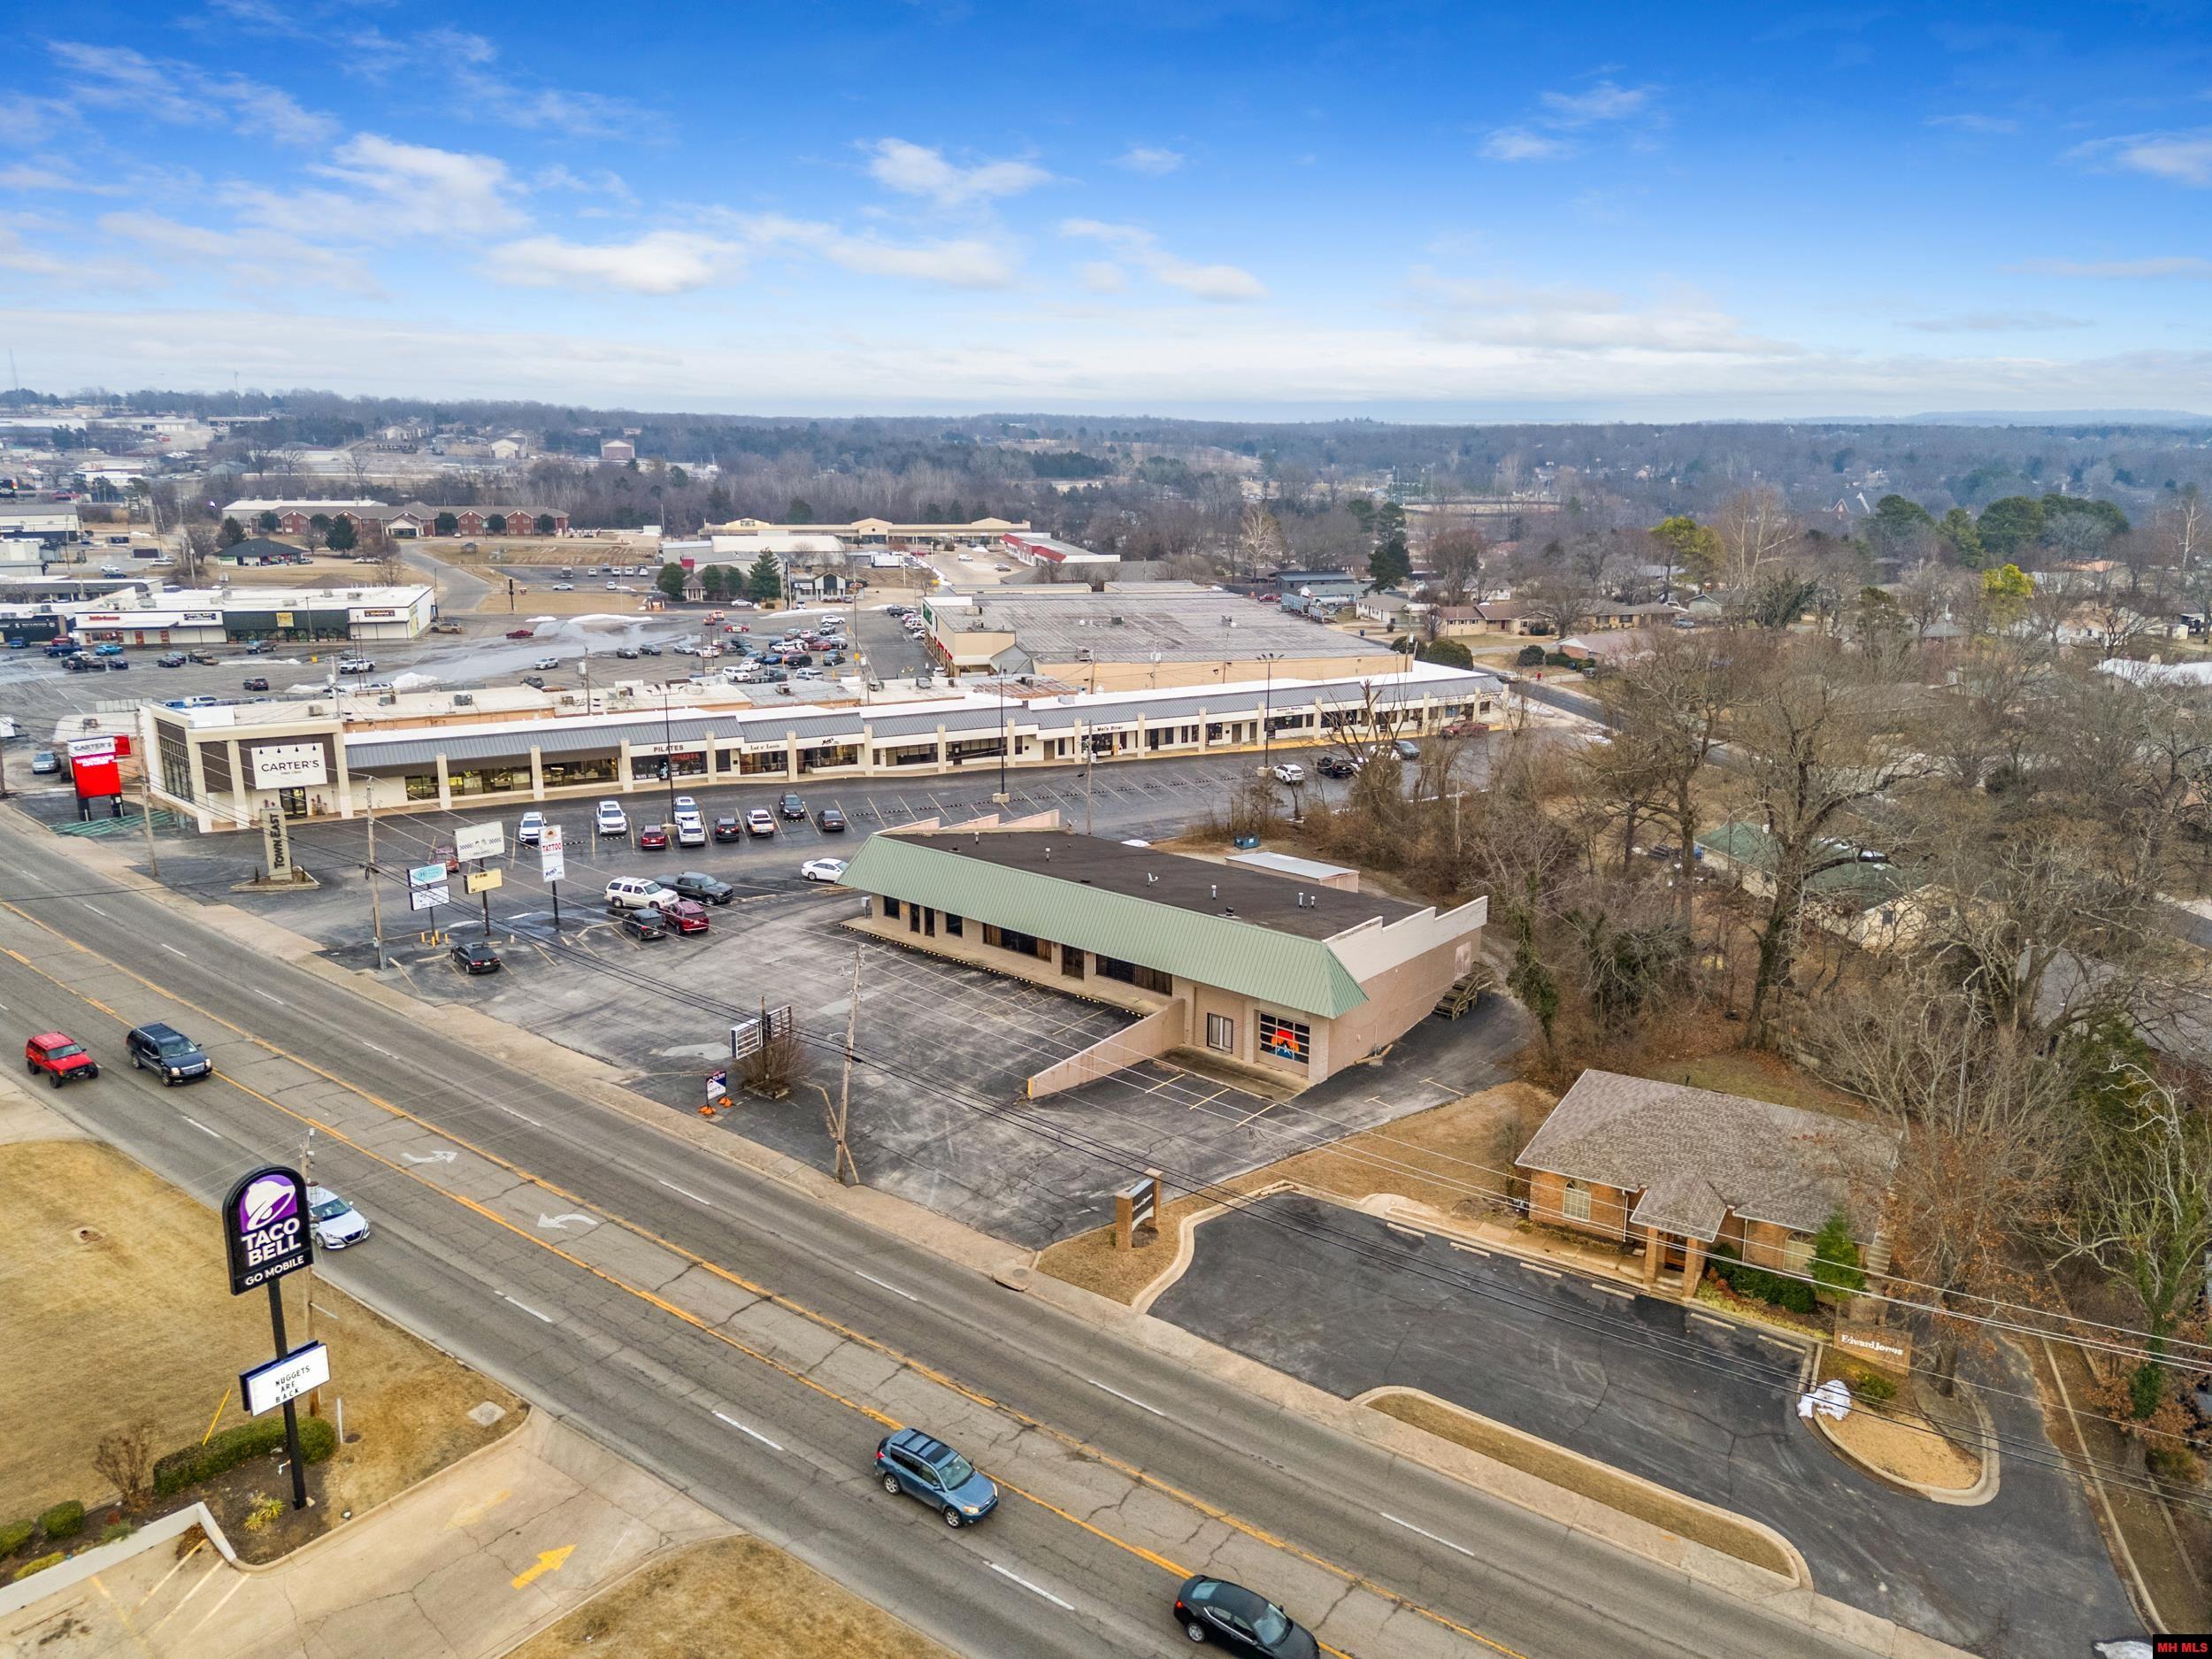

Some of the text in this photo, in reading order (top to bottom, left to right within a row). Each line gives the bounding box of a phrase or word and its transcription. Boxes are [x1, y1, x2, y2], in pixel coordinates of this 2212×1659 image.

[73, 742, 112, 751] CARTER'S
[261, 759, 319, 772] CARTER'S
[541, 842, 563, 852] TATTOO
[241, 1217, 300, 1251] TACO
[248, 1234, 301, 1267] BELL
[245, 1255, 304, 1286] GO MOBILE
[275, 1364, 311, 1386] NUGGETS
[275, 1387, 299, 1403] BACK
[281, 1381, 295, 1393] ARE
